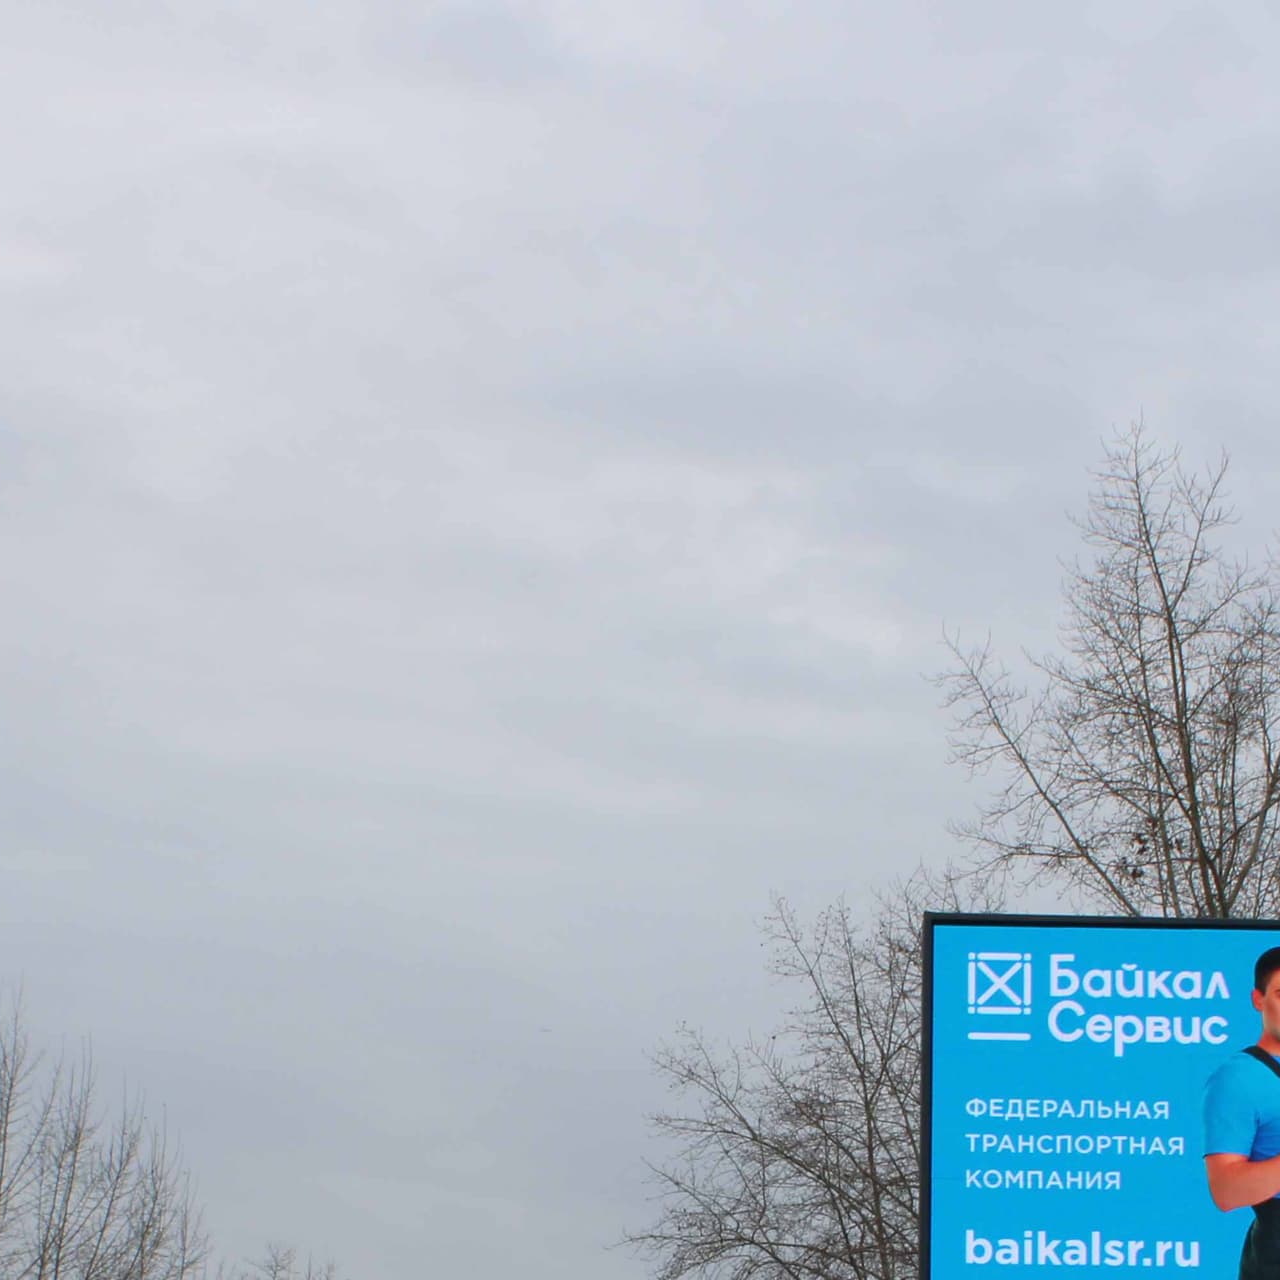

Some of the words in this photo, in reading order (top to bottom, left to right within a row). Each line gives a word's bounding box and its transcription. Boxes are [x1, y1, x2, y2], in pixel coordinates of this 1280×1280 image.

[1049, 953, 1231, 1000] Байкал
[1047, 999, 1230, 1058] Сервис
[964, 1097, 1171, 1122] ФЕДЕРАЛЬНАЯ
[964, 1133, 1186, 1157] ТРАНСПОРТНАЯ
[964, 1168, 1122, 1191] КОМПАНИЯ
[964, 1228, 1201, 1268] baikalsr.ru
